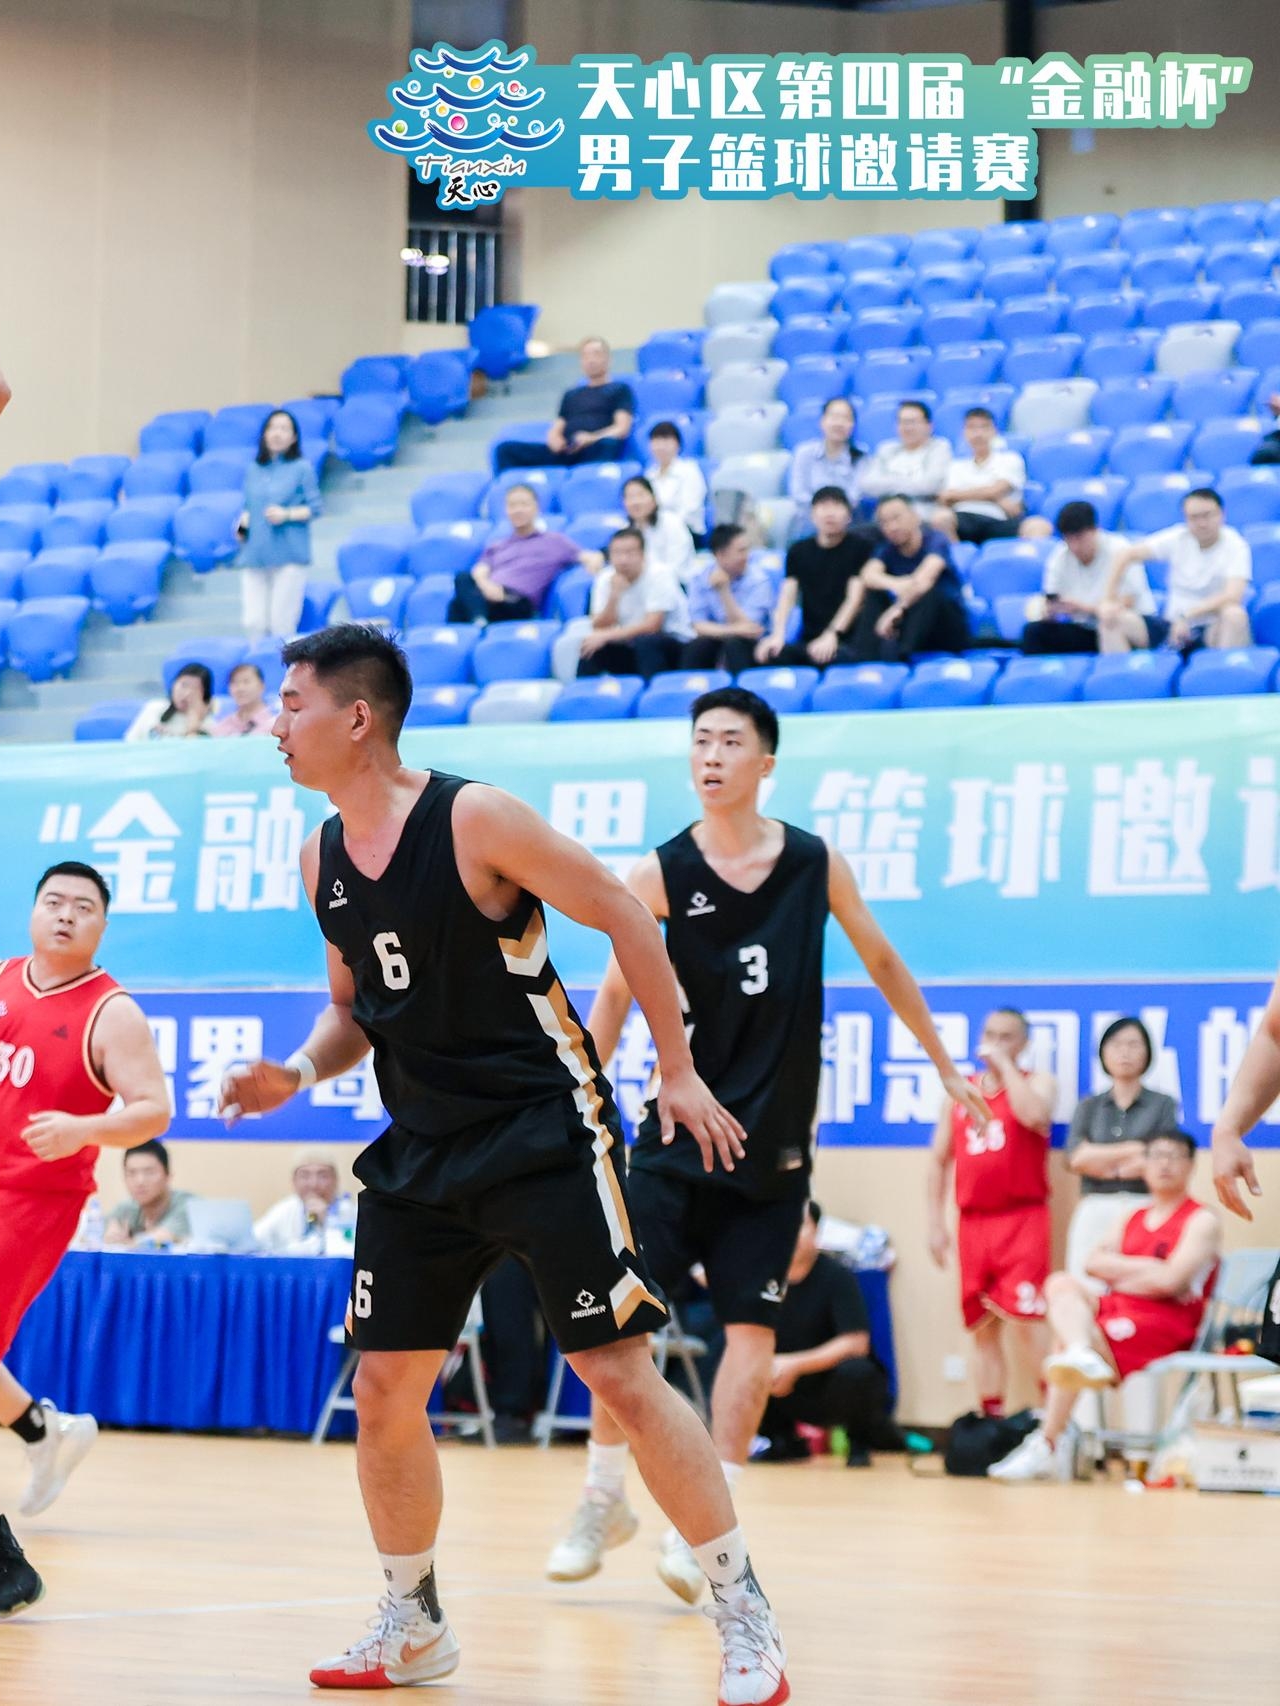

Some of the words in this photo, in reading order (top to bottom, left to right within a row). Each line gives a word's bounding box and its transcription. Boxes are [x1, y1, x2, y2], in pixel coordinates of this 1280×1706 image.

[372, 931, 411, 991] 6
[738, 943, 769, 996] 3
[354, 1269, 374, 1319] 6
